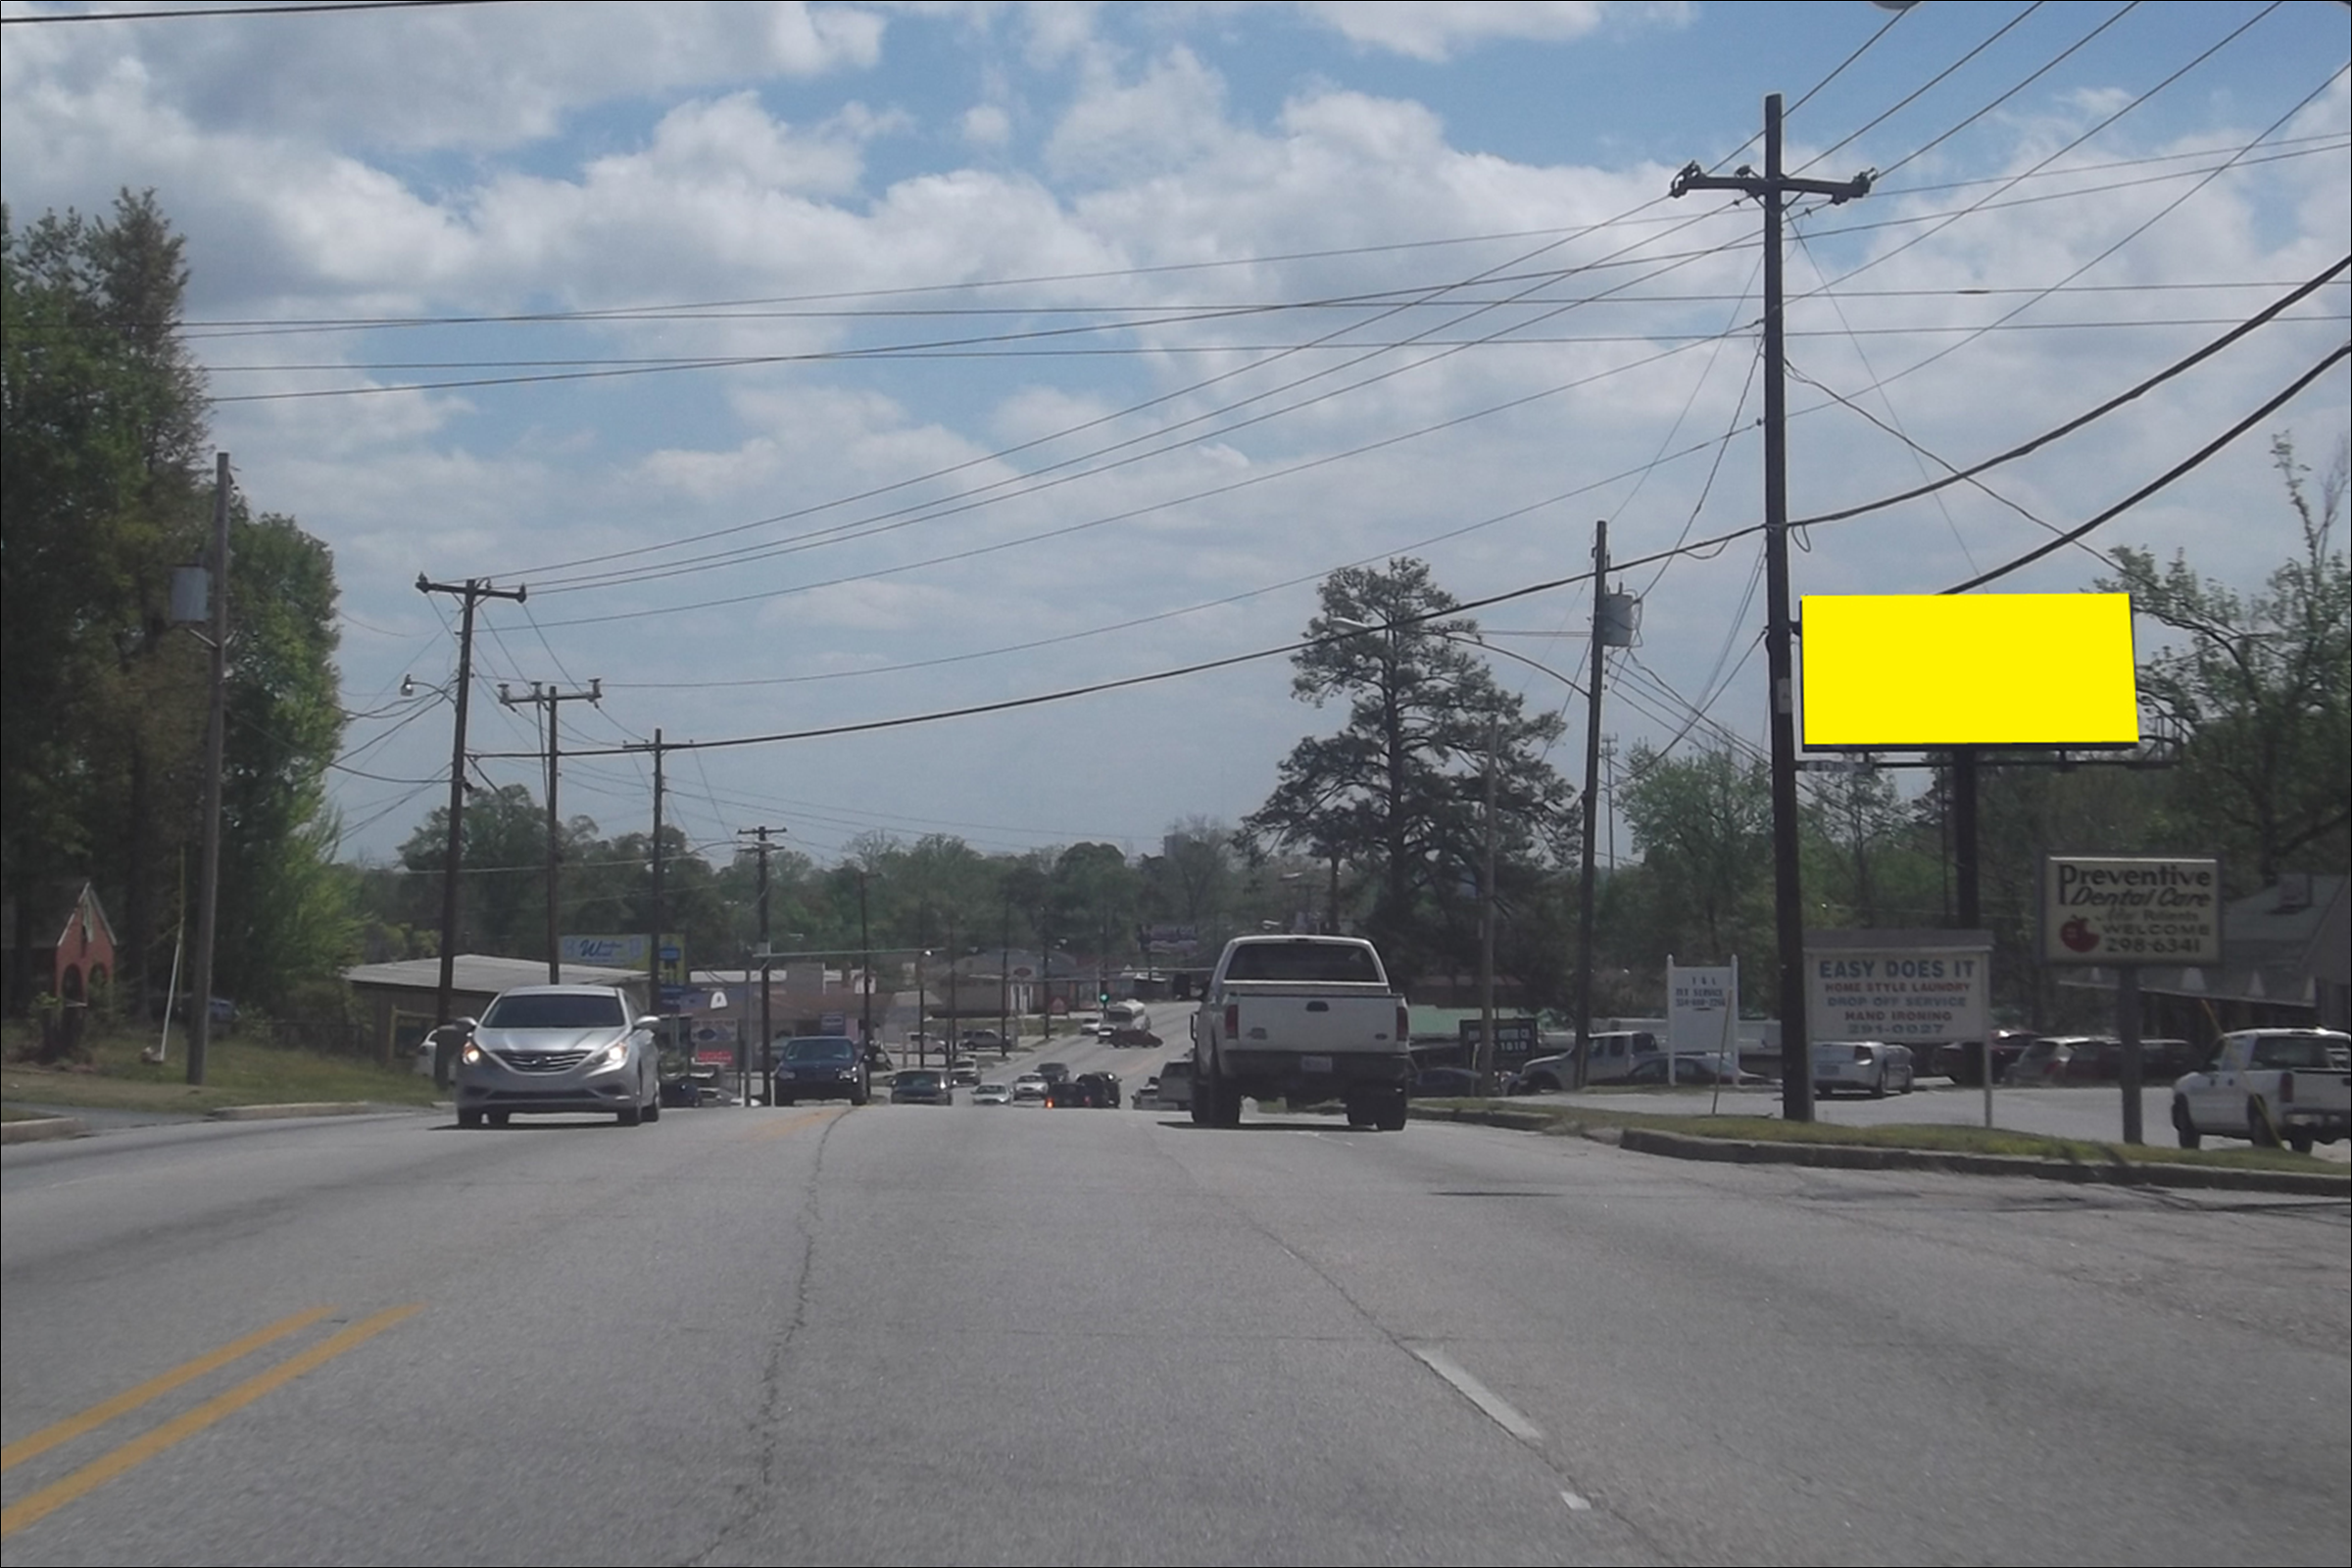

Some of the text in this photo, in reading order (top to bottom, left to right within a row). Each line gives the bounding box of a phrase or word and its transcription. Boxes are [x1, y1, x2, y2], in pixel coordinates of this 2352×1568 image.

[2059, 863, 2211, 906] Preventive
[2070, 886, 2212, 907] Dental Care
[2102, 923, 2210, 936] WELCOME
[2105, 938, 2201, 954] 298-6341
[1819, 959, 1975, 979] EASY DOES IT
[1825, 982, 1971, 993] HOME STYLE LAUNDRY
[1827, 996, 1967, 1007] DROP OFF SERVICE
[1844, 1010, 1953, 1021] HAND IRONING
[1847, 1023, 1944, 1035] 291-0027
